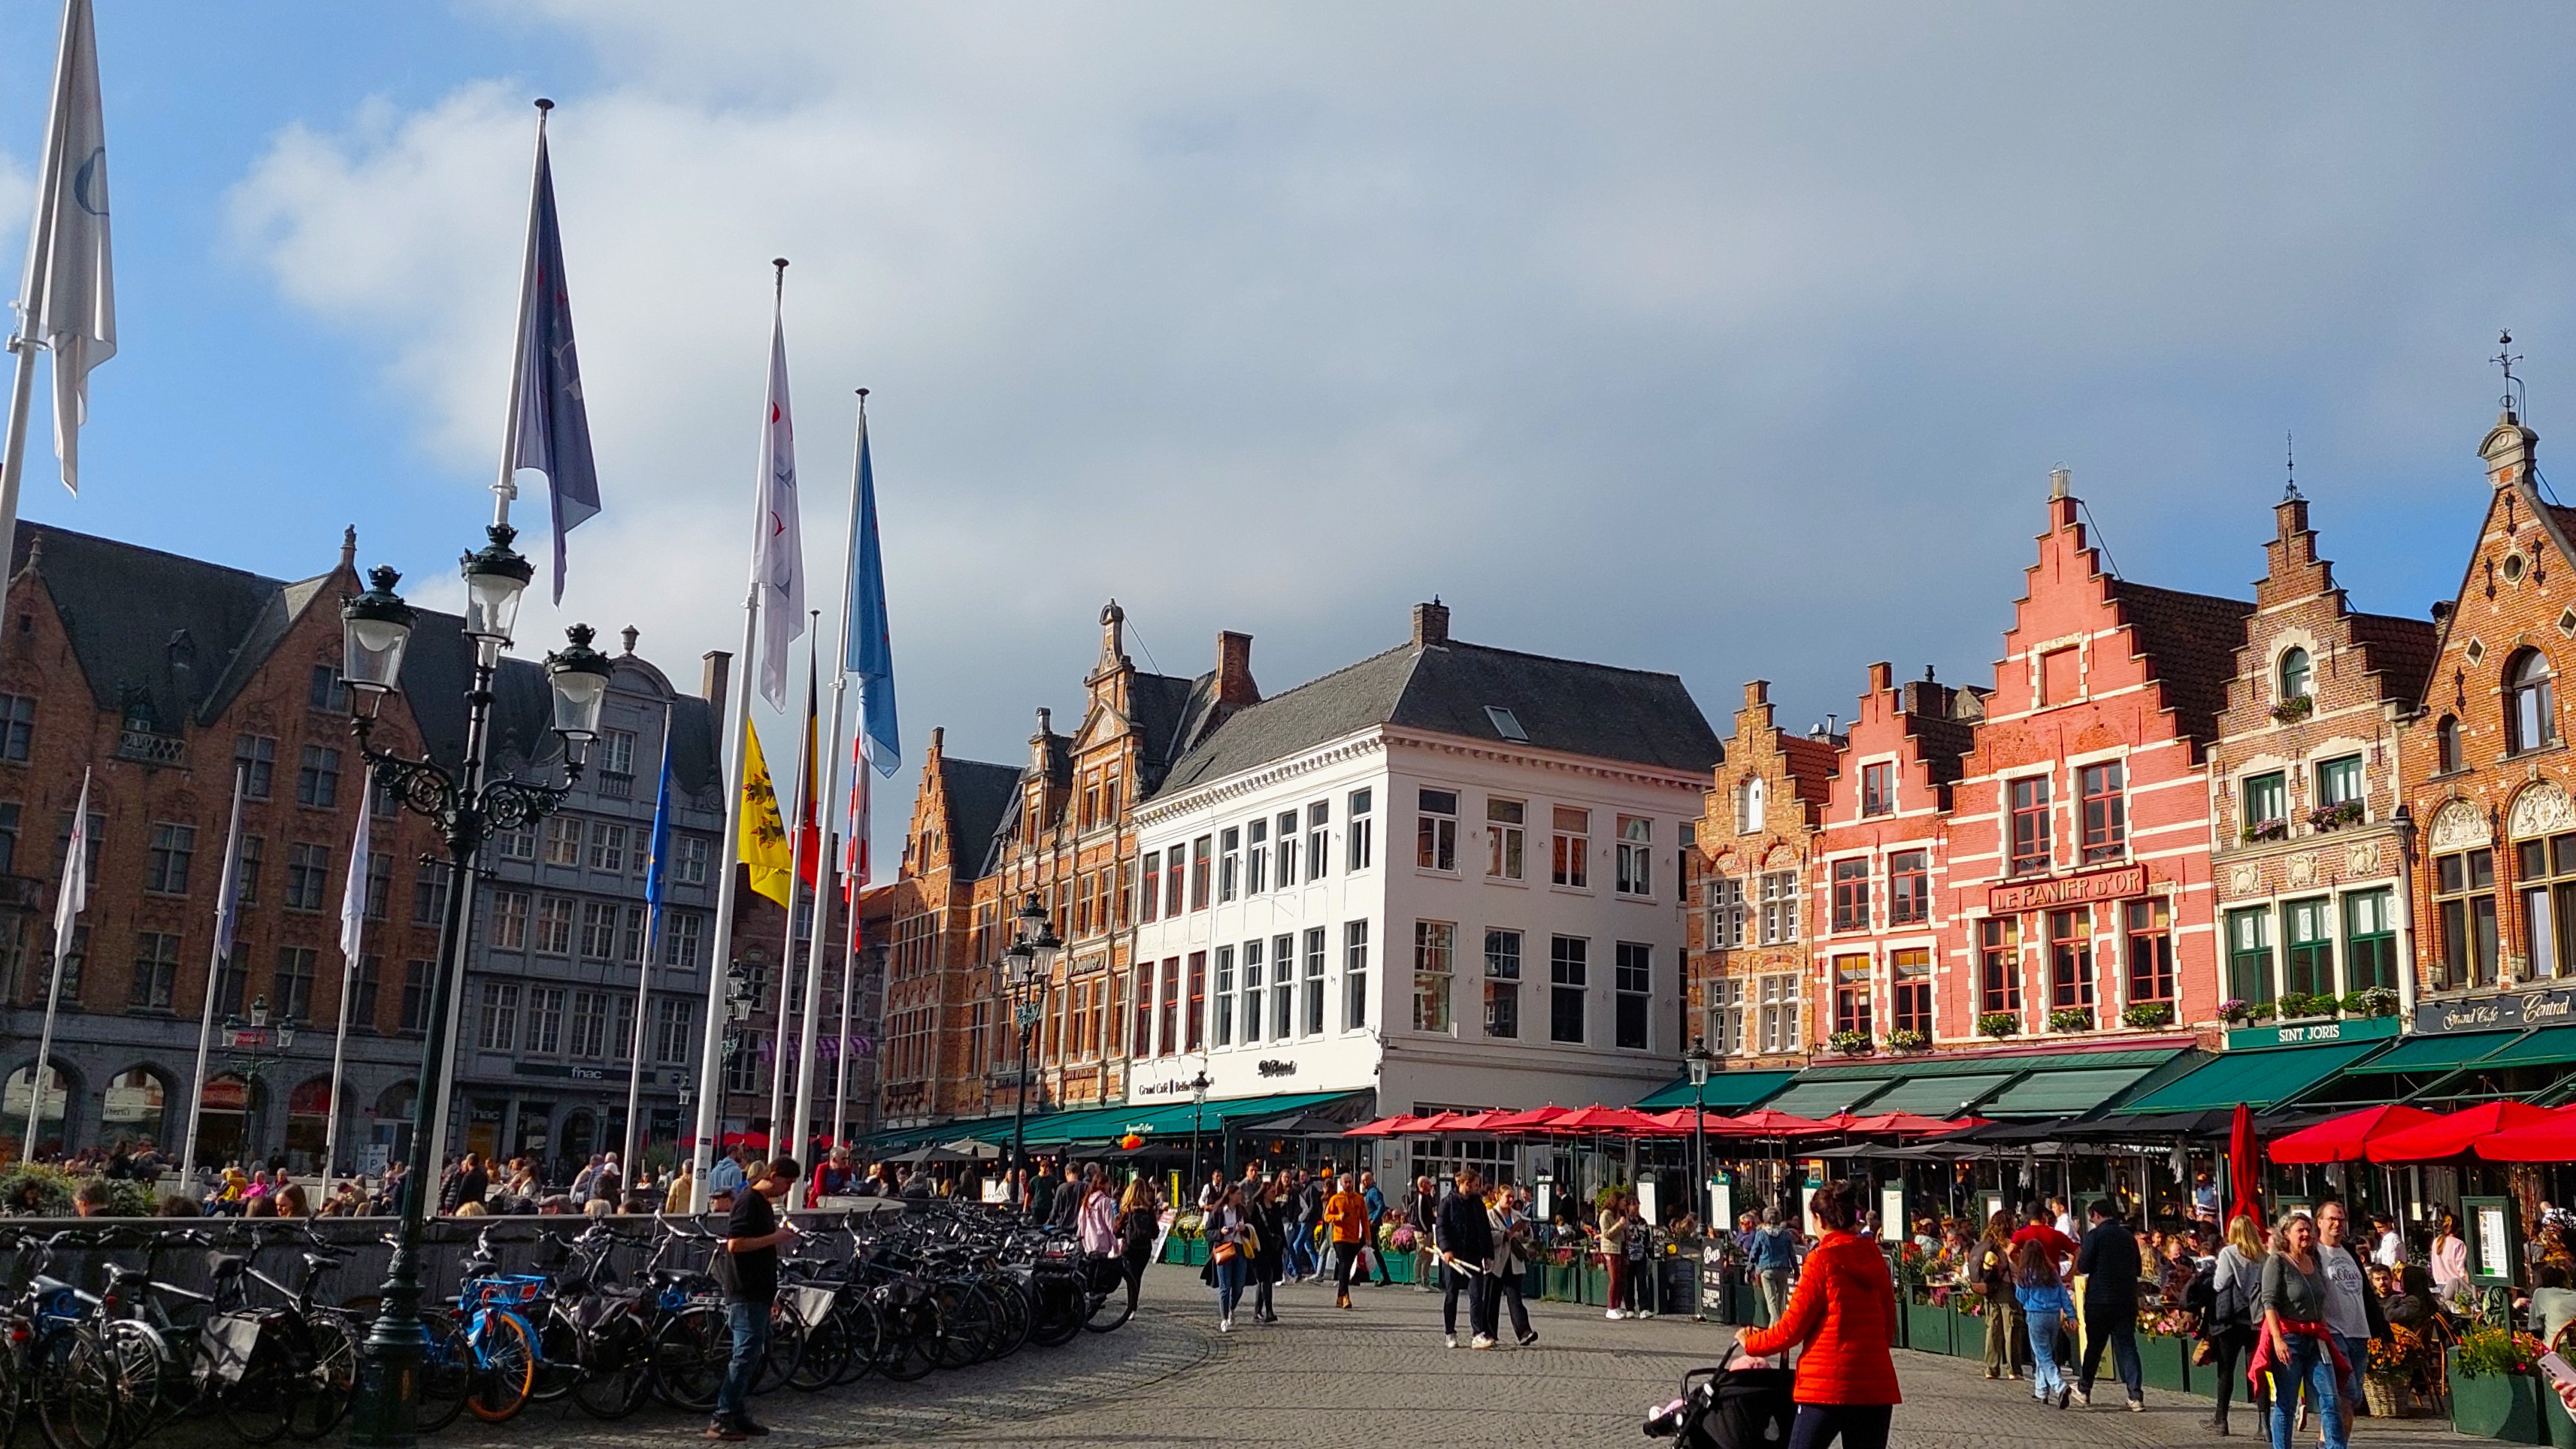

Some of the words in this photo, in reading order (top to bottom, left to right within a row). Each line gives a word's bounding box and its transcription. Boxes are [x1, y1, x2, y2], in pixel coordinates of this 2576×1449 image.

[1996, 893, 2018, 909] LE
[2021, 877, 2090, 907] PANIER
[1075, 955, 1100, 973] Jupiler
[2443, 1009, 2476, 1030] Grand
[2521, 994, 2570, 1023] Central
[2278, 1027, 2305, 1042] SINT
[2306, 1024, 2340, 1040] JORIS
[571, 1066, 602, 1079] fnac
[1139, 1084, 1155, 1096] Grand
